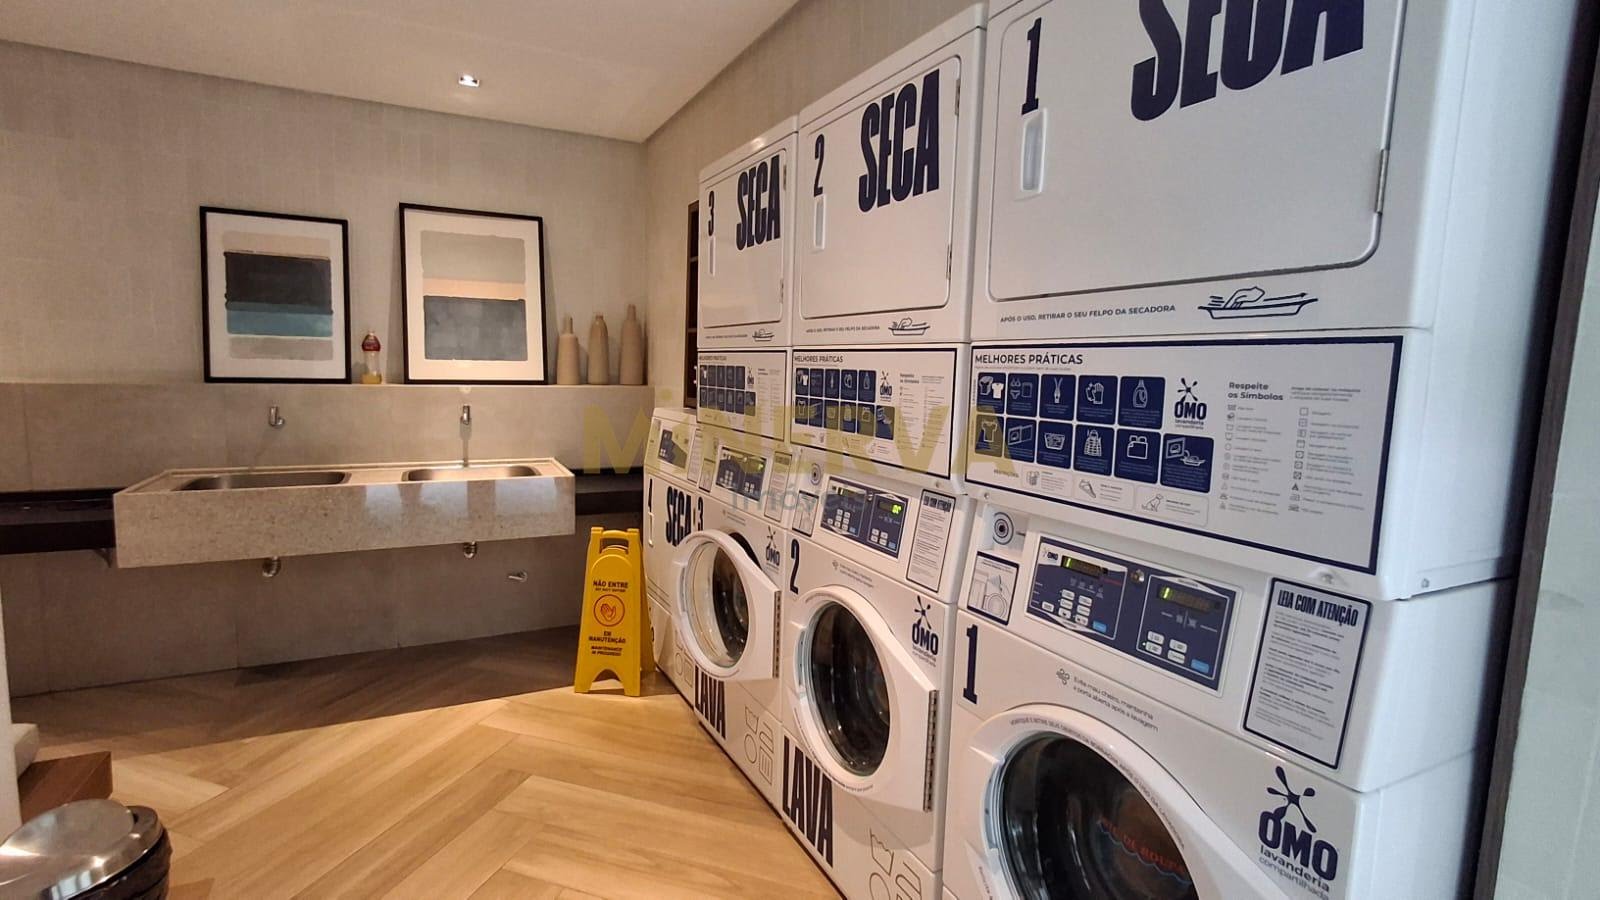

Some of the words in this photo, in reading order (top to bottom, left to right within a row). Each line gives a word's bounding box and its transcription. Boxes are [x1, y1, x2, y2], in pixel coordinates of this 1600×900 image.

[1021, 17, 1042, 115] 1
[858, 69, 939, 212] SECA
[813, 134, 825, 196] 2
[707, 190, 715, 237] 3
[736, 154, 780, 250] SECA
[1037, 312, 1066, 320] RETIRAR
[1067, 311, 1073, 319] O
[1074, 310, 1088, 318] SEU
[1089, 308, 1113, 317] FELPO
[1115, 307, 1127, 316] DA
[1128, 304, 1176, 315] SECADORA
[975, 354, 1026, 364] MELHORES
[1028, 352, 1084, 365] PRÁTICAS
[1227, 392, 1238, 400] os
[1240, 391, 1284, 401] Símbolos
[1229, 382, 1269, 391] Respeite
[1174, 400, 1207, 420] OMO
[665, 485, 692, 547] SECA
[697, 496, 704, 531] 3
[765, 545, 780, 566] OMO
[790, 538, 800, 595] 2
[593, 578, 606, 587] NÃO
[1277, 589, 1295, 610] LEIA
[1294, 593, 1317, 616] COM
[1316, 600, 1360, 627] ATENÇÃO
[911, 622, 939, 655] OMO
[963, 624, 979, 705] 1
[694, 665, 727, 740] LAVA
[1088, 684, 1101, 694] mau
[1121, 700, 1154, 720] mantenha
[1131, 714, 1159, 733] lavagem
[783, 735, 834, 868] LAVA
[1258, 810, 1338, 881] OMO
[1260, 845, 1330, 893] lavanderia
